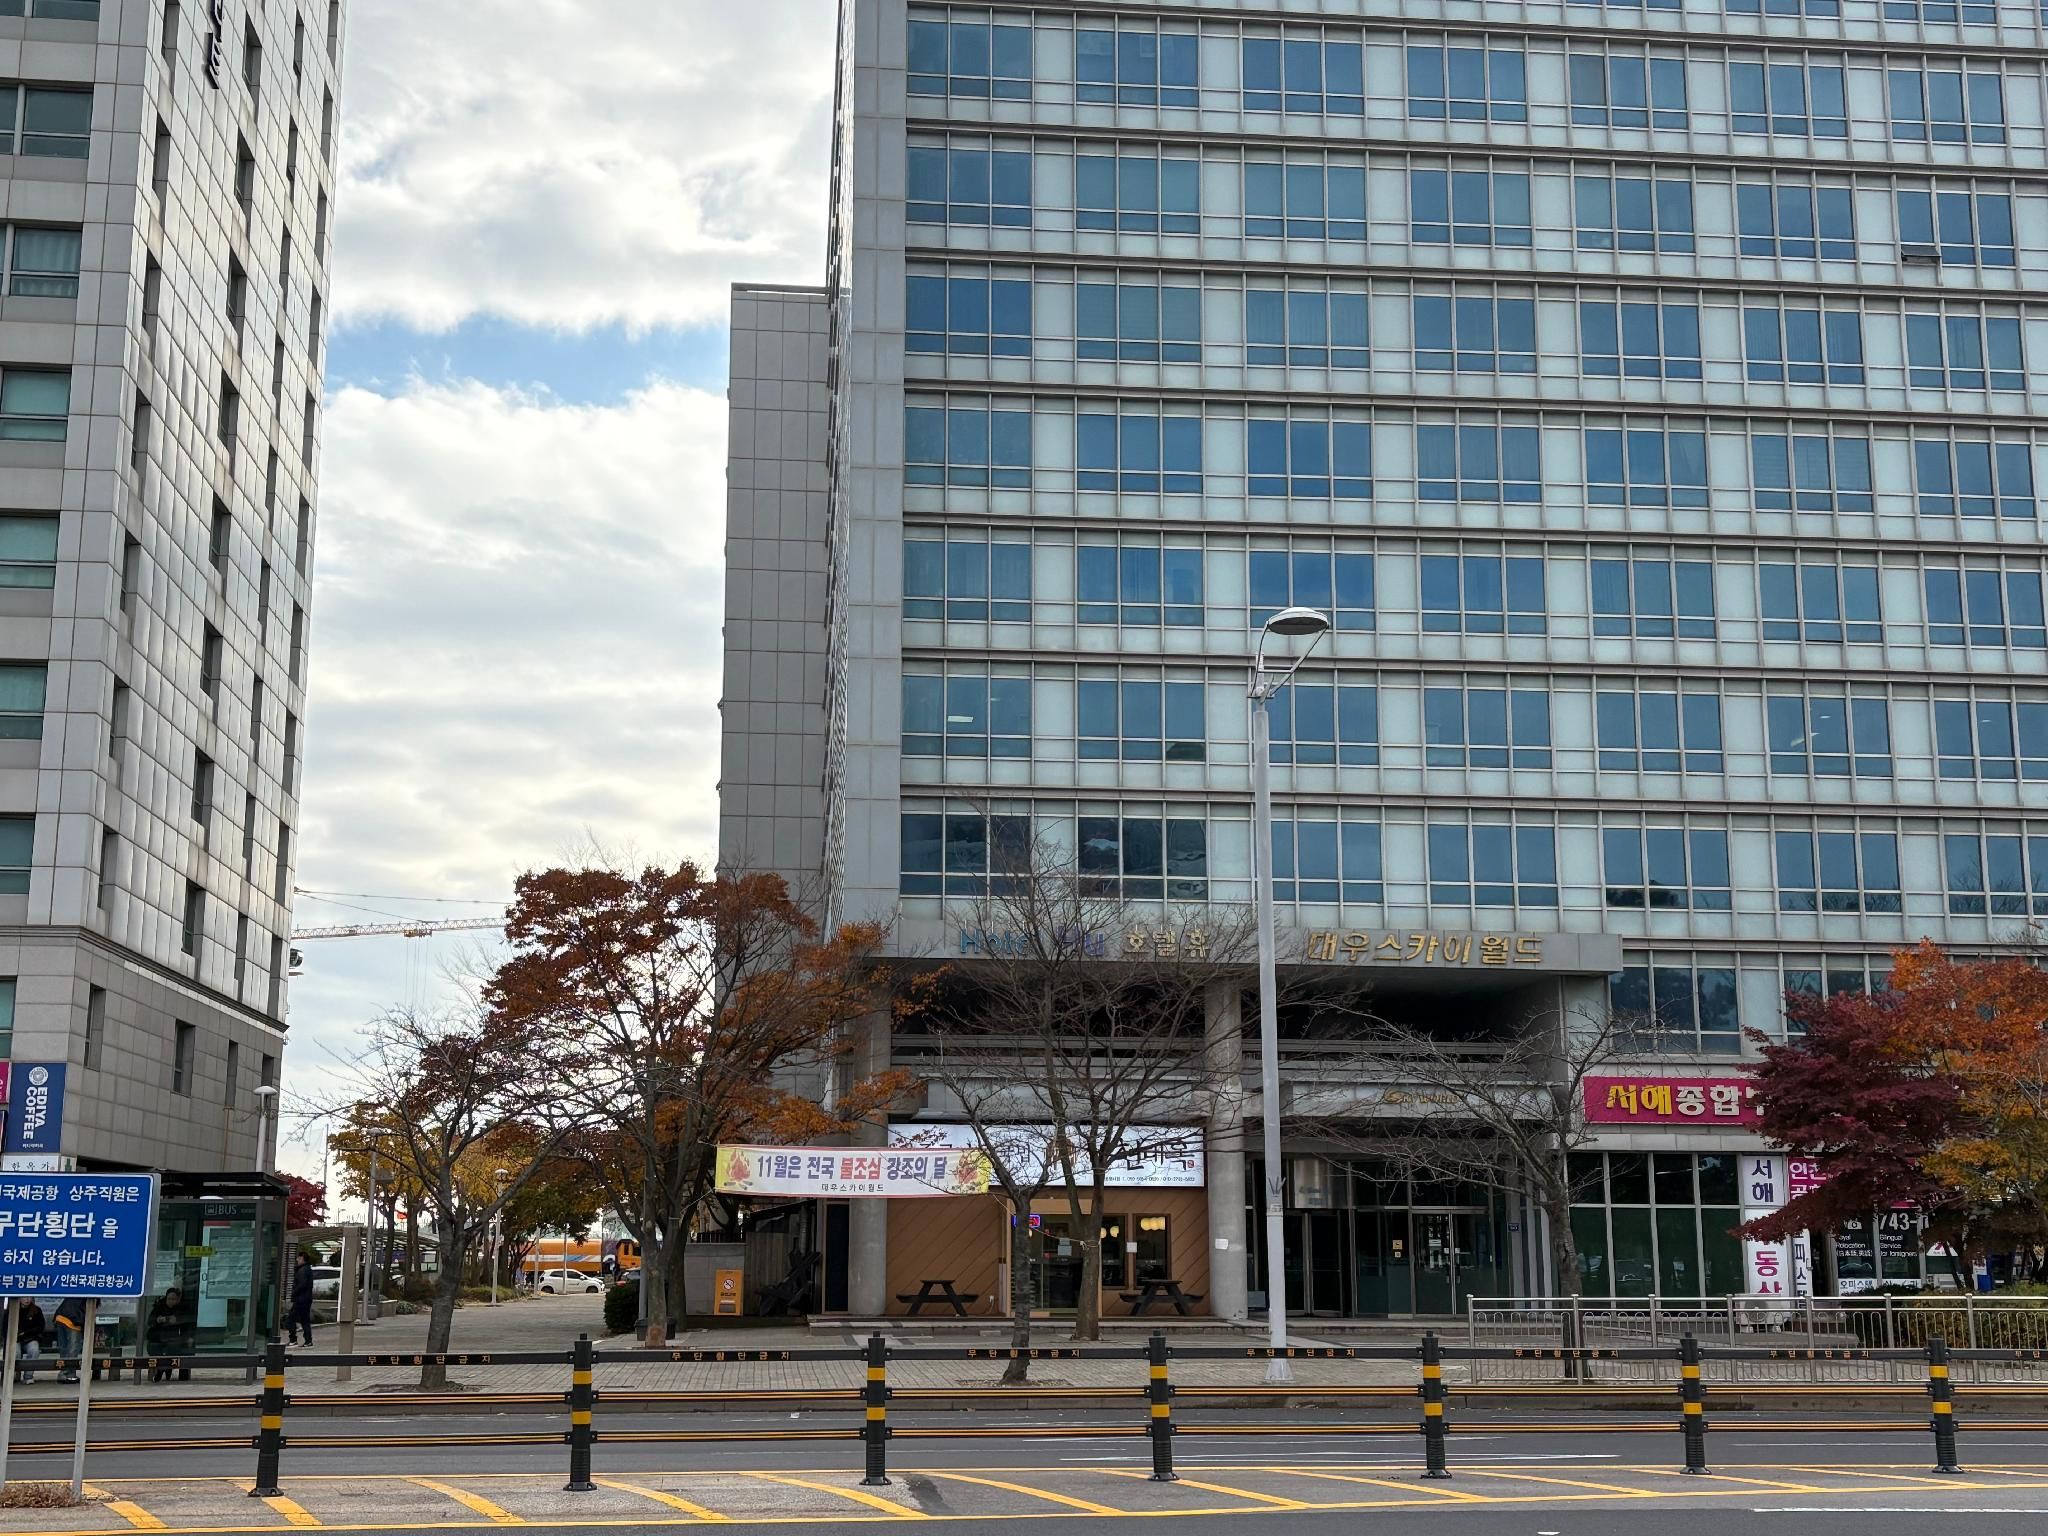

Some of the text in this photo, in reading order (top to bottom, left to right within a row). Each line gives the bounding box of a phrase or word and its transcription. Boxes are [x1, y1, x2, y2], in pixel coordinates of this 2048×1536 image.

[1307, 931, 1543, 965] 대우스카이월드
[23, 1086, 37, 1140] COFFEE
[34, 1086, 48, 1127] EDIYA
[757, 1155, 948, 1181] 11월은 전국 불조심 강조의 달
[0, 1184, 140, 1202] 국제공항 상주직원은
[821, 1184, 884, 1193] 대우스카이월드
[218, 1204, 237, 1215] BUS
[0, 1211, 119, 1239] 무단횡단 을
[3, 1249, 105, 1266] 하지 않습니다.
[56, 1357, 181, 1369] 무횡단금지
